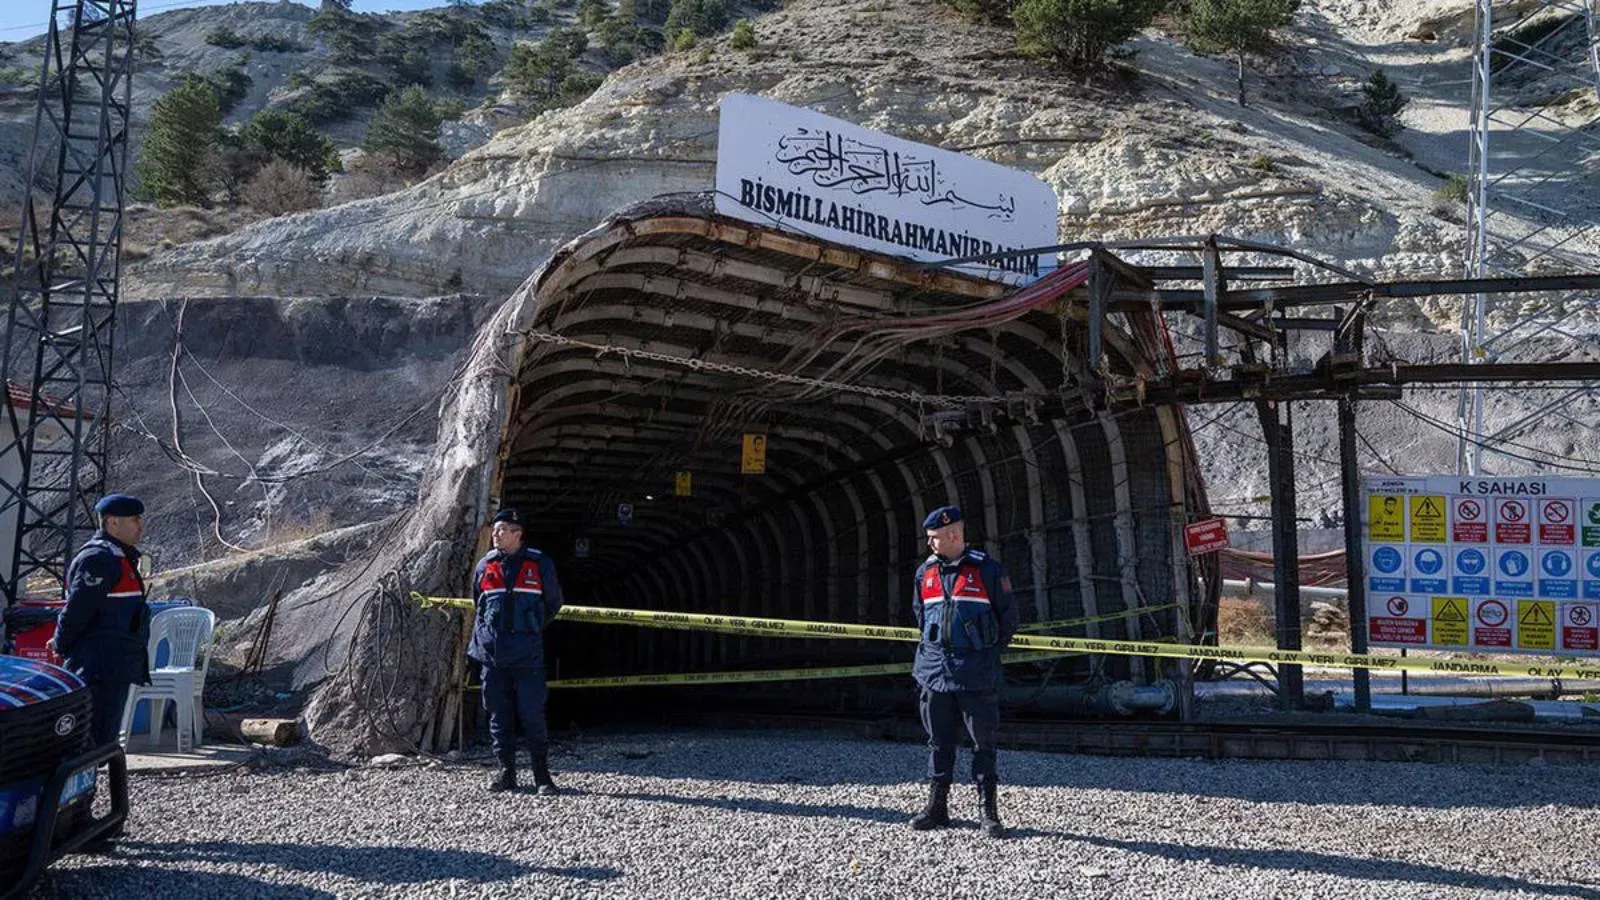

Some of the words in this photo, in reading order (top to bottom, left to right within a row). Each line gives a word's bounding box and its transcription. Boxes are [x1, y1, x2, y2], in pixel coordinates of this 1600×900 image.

[1460, 480, 1473, 493] K
[1478, 481, 1547, 495] SAHASI
[704, 617, 723, 625] OLAY
[805, 624, 847, 634] JANDARMA
[864, 628, 886, 637] OLAY
[1050, 639, 1075, 649] OLAY
[1187, 648, 1245, 659] JANDARMA
[1268, 651, 1298, 662] OLAY
[1430, 661, 1499, 674] JANDARMA
[1527, 667, 1564, 677] OLAY
